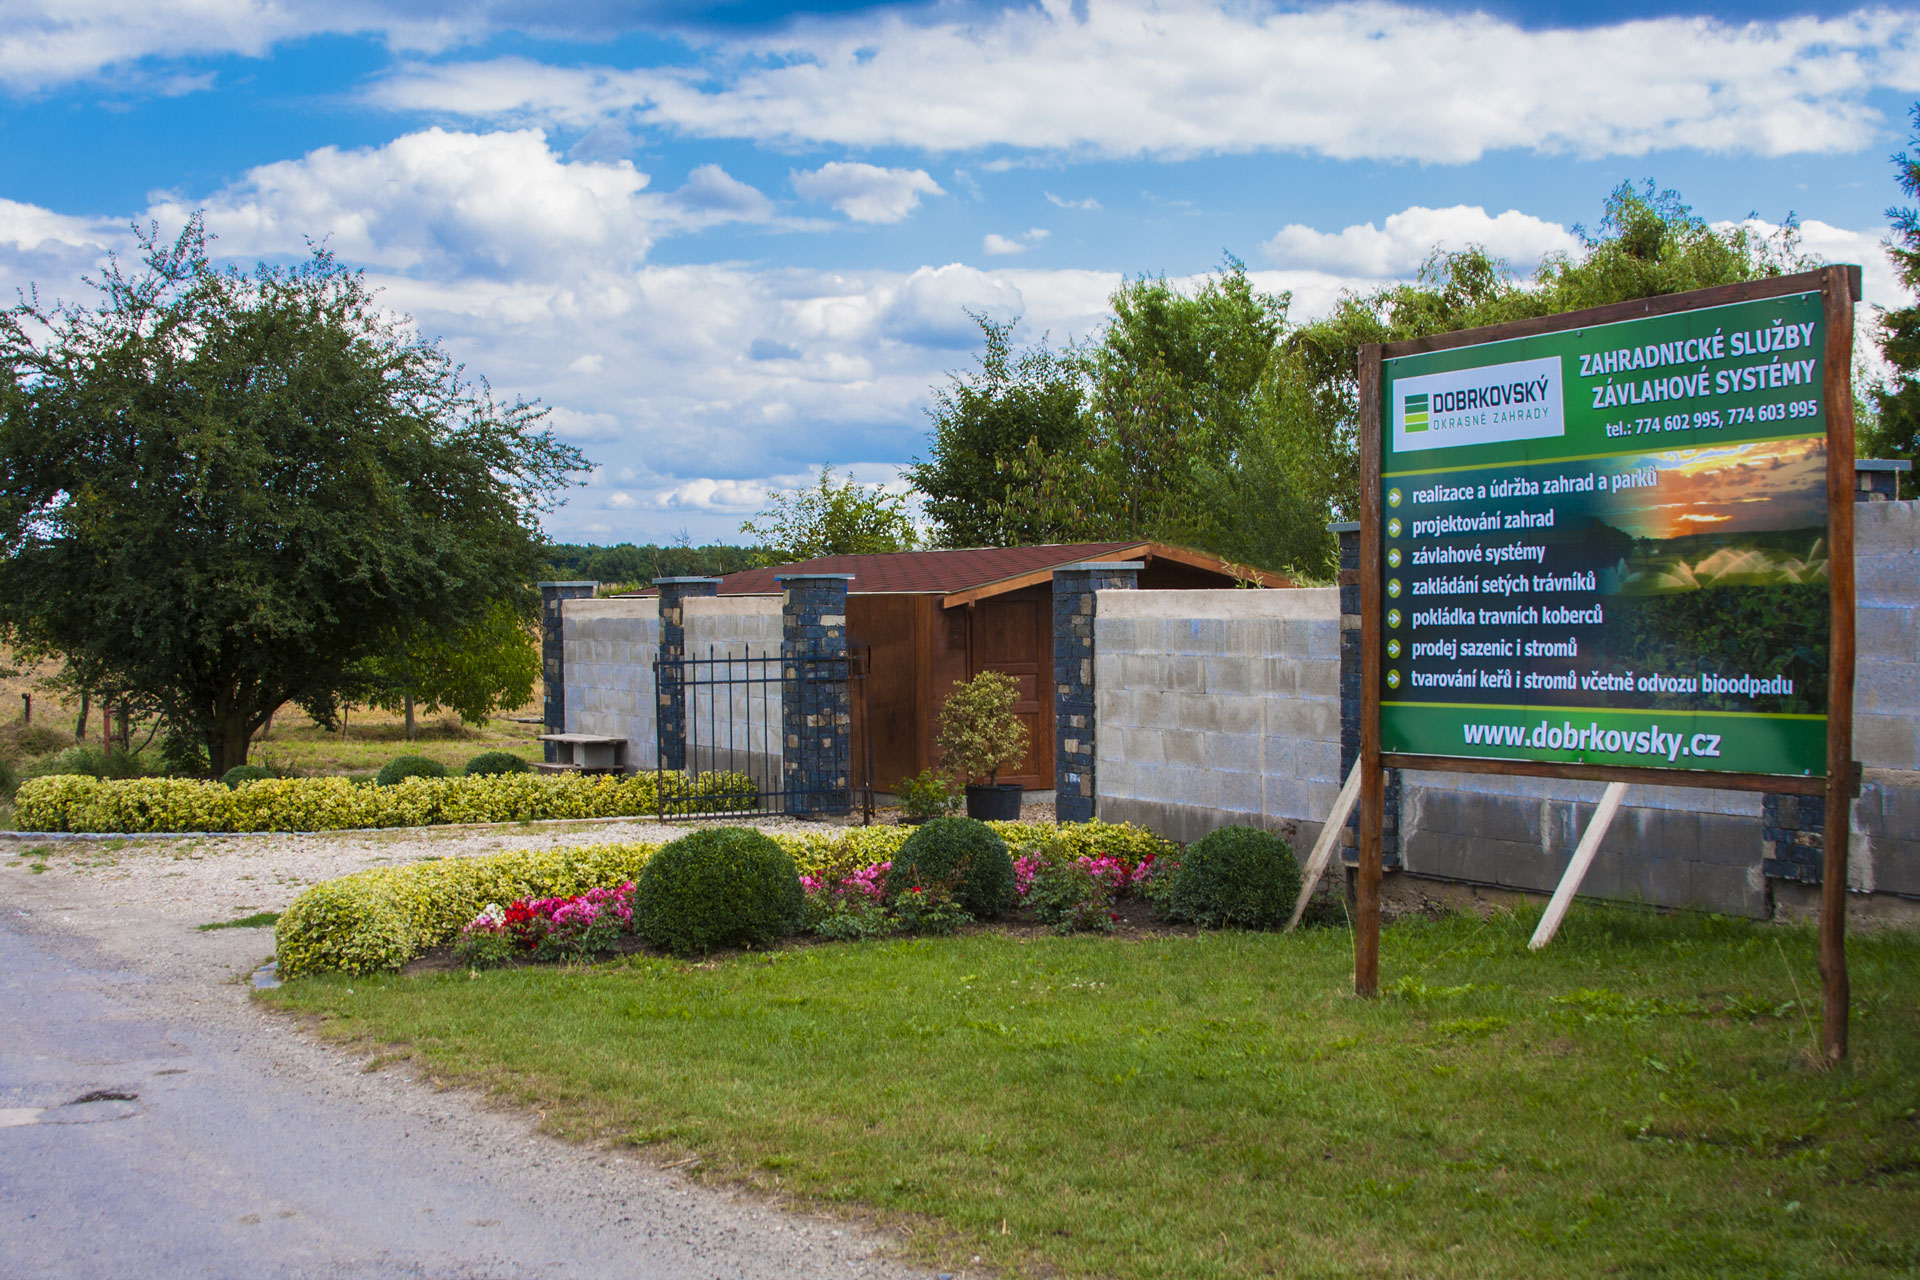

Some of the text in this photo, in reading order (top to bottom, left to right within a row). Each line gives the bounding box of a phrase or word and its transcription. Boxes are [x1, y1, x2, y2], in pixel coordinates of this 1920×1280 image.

[1580, 319, 1816, 377] ZAHRADNICKÉ SLUŽBY
[1433, 374, 1549, 413] DOBRKOVSKÝ
[1592, 355, 1816, 409] ZÁVLAHOVÉ SYSTÉMY
[1433, 407, 1549, 430] OKRASNÉ ZAHRADY
[1606, 400, 1817, 437] tel.: 774 602 995, 774 603 995
[1412, 467, 1658, 504] realizace a údržba zahrad a parků
[1412, 509, 1554, 538] projektování zahrad
[1412, 544, 1546, 566] závlahové systémy
[1412, 572, 1596, 595] zakládání setých trávníků
[1412, 604, 1603, 629] pokládka travních koberců
[1412, 637, 1577, 660] prodej sazenic i stromů
[1411, 669, 1794, 698] tvarování keřů i stromů včetně odvozu bioodpadu
[1463, 720, 1721, 762] www.dobrkovsky.cz
